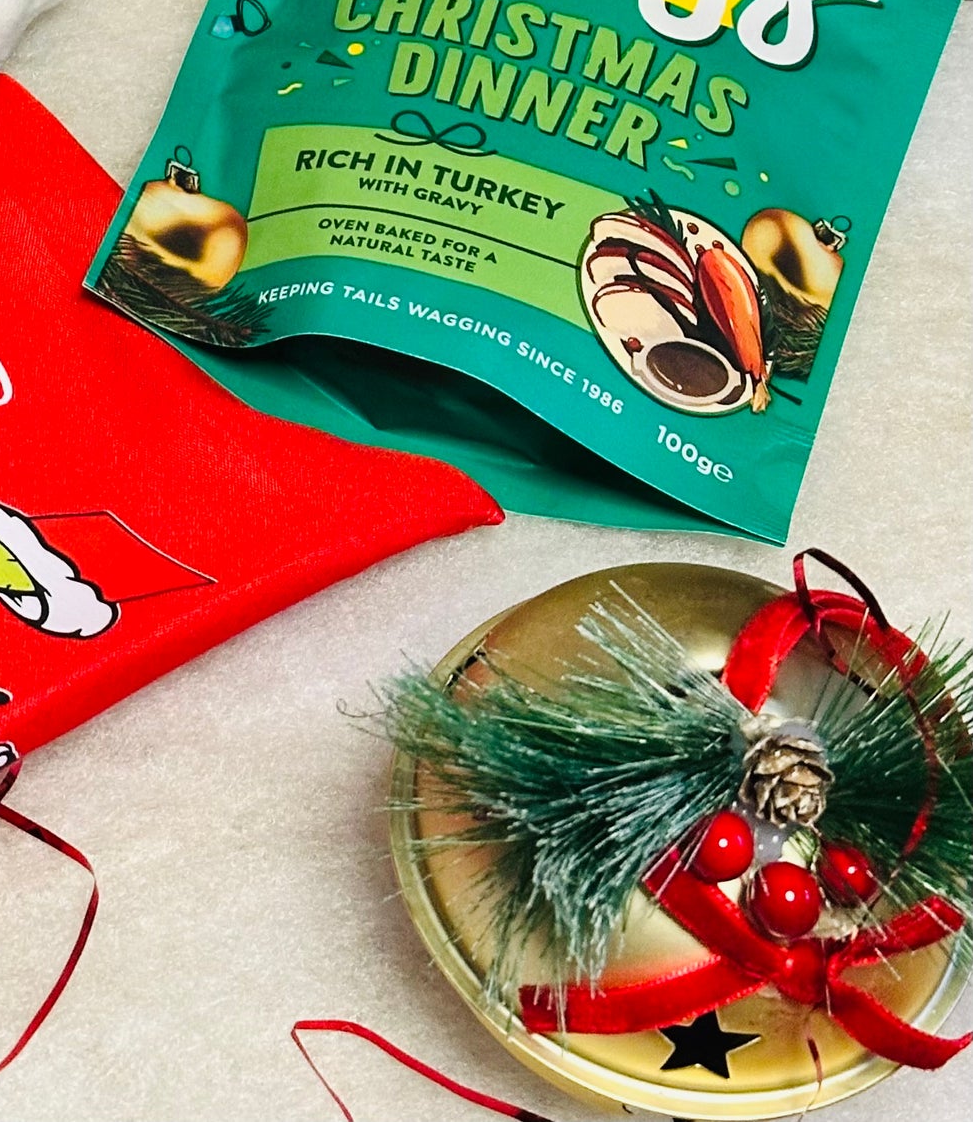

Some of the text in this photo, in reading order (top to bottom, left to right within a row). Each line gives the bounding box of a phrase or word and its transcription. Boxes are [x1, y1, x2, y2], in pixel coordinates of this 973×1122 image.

[388, 41, 663, 170] DINNER
[295, 149, 566, 221] RICH IN TURKEY
[357, 177, 484, 217] WITH GRAVY
[318, 218, 498, 265] OVEN BAKED FOR A
[329, 235, 476, 274] NATURAL TASTE
[258, 281, 625, 416] KEEPING TAILS WAGGING SINCE 1986
